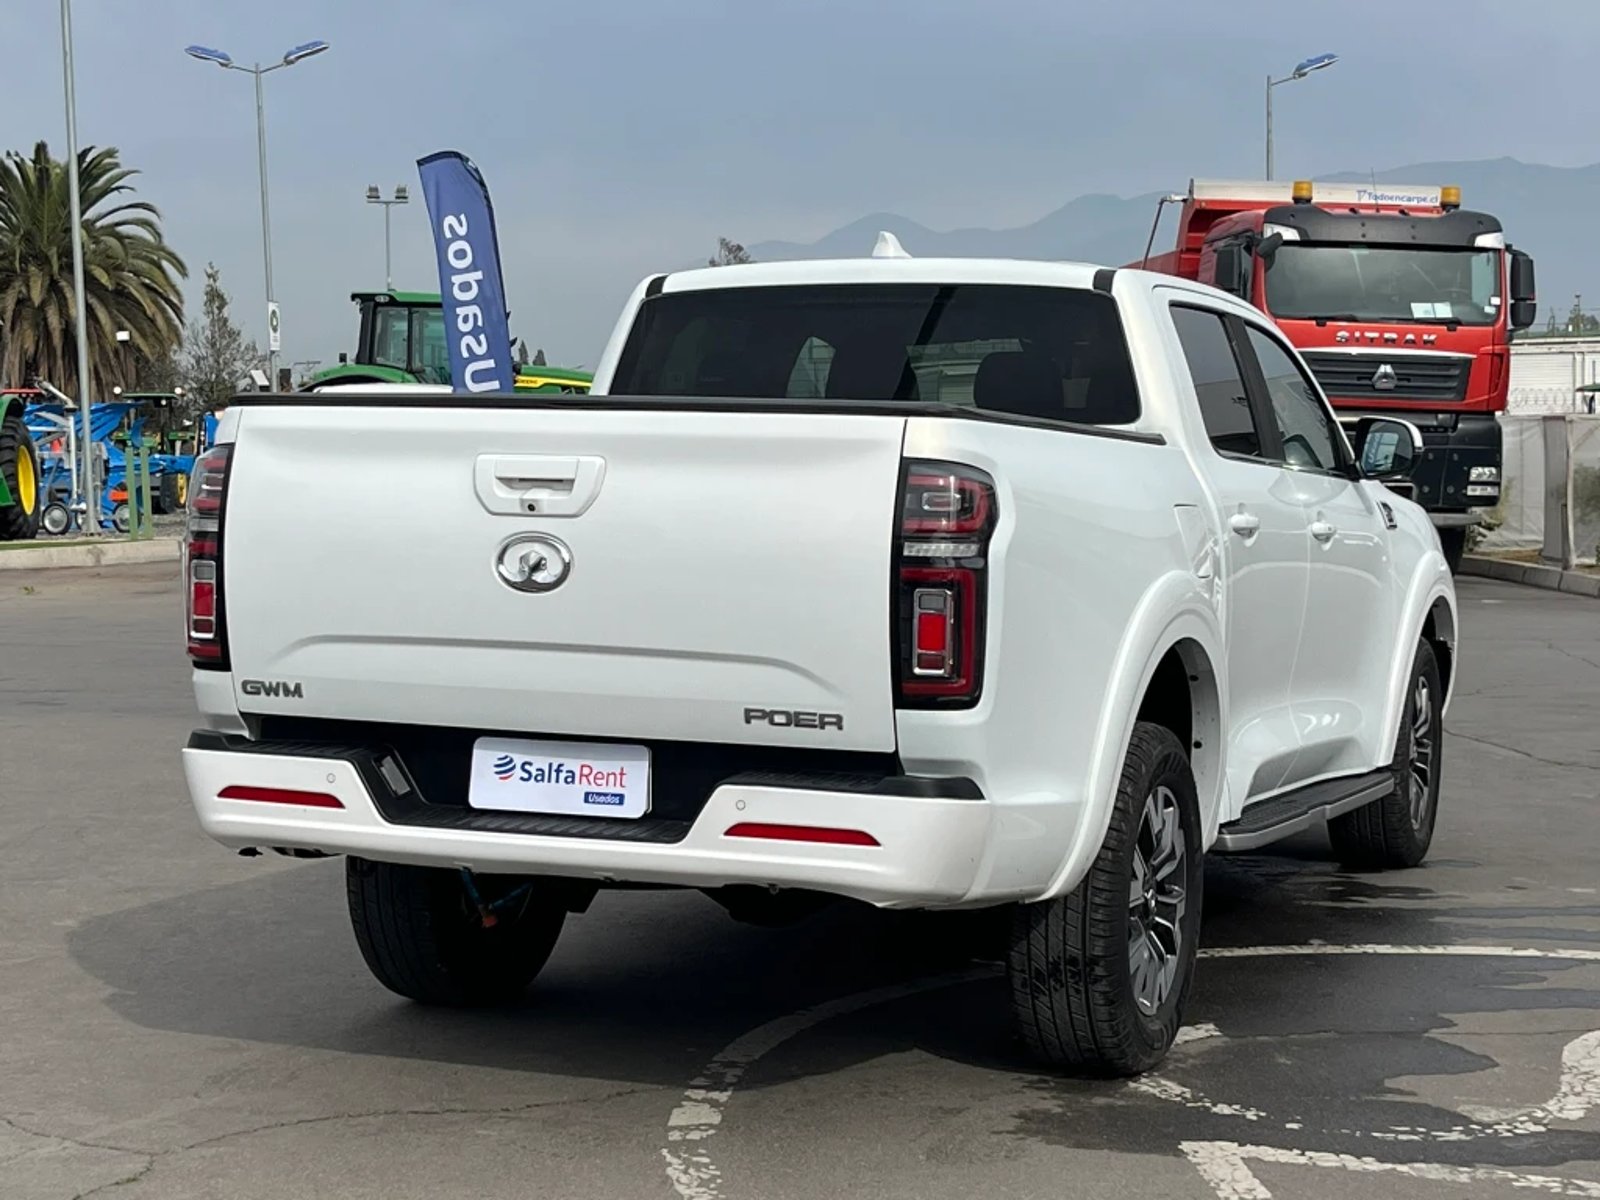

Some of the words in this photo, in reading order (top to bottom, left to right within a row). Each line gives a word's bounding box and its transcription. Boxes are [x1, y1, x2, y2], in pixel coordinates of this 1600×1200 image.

[1335, 330, 1437, 345] SITRAK
[241, 680, 304, 699] GWM
[743, 707, 843, 731] POER
[588, 793, 620, 804] Usados
